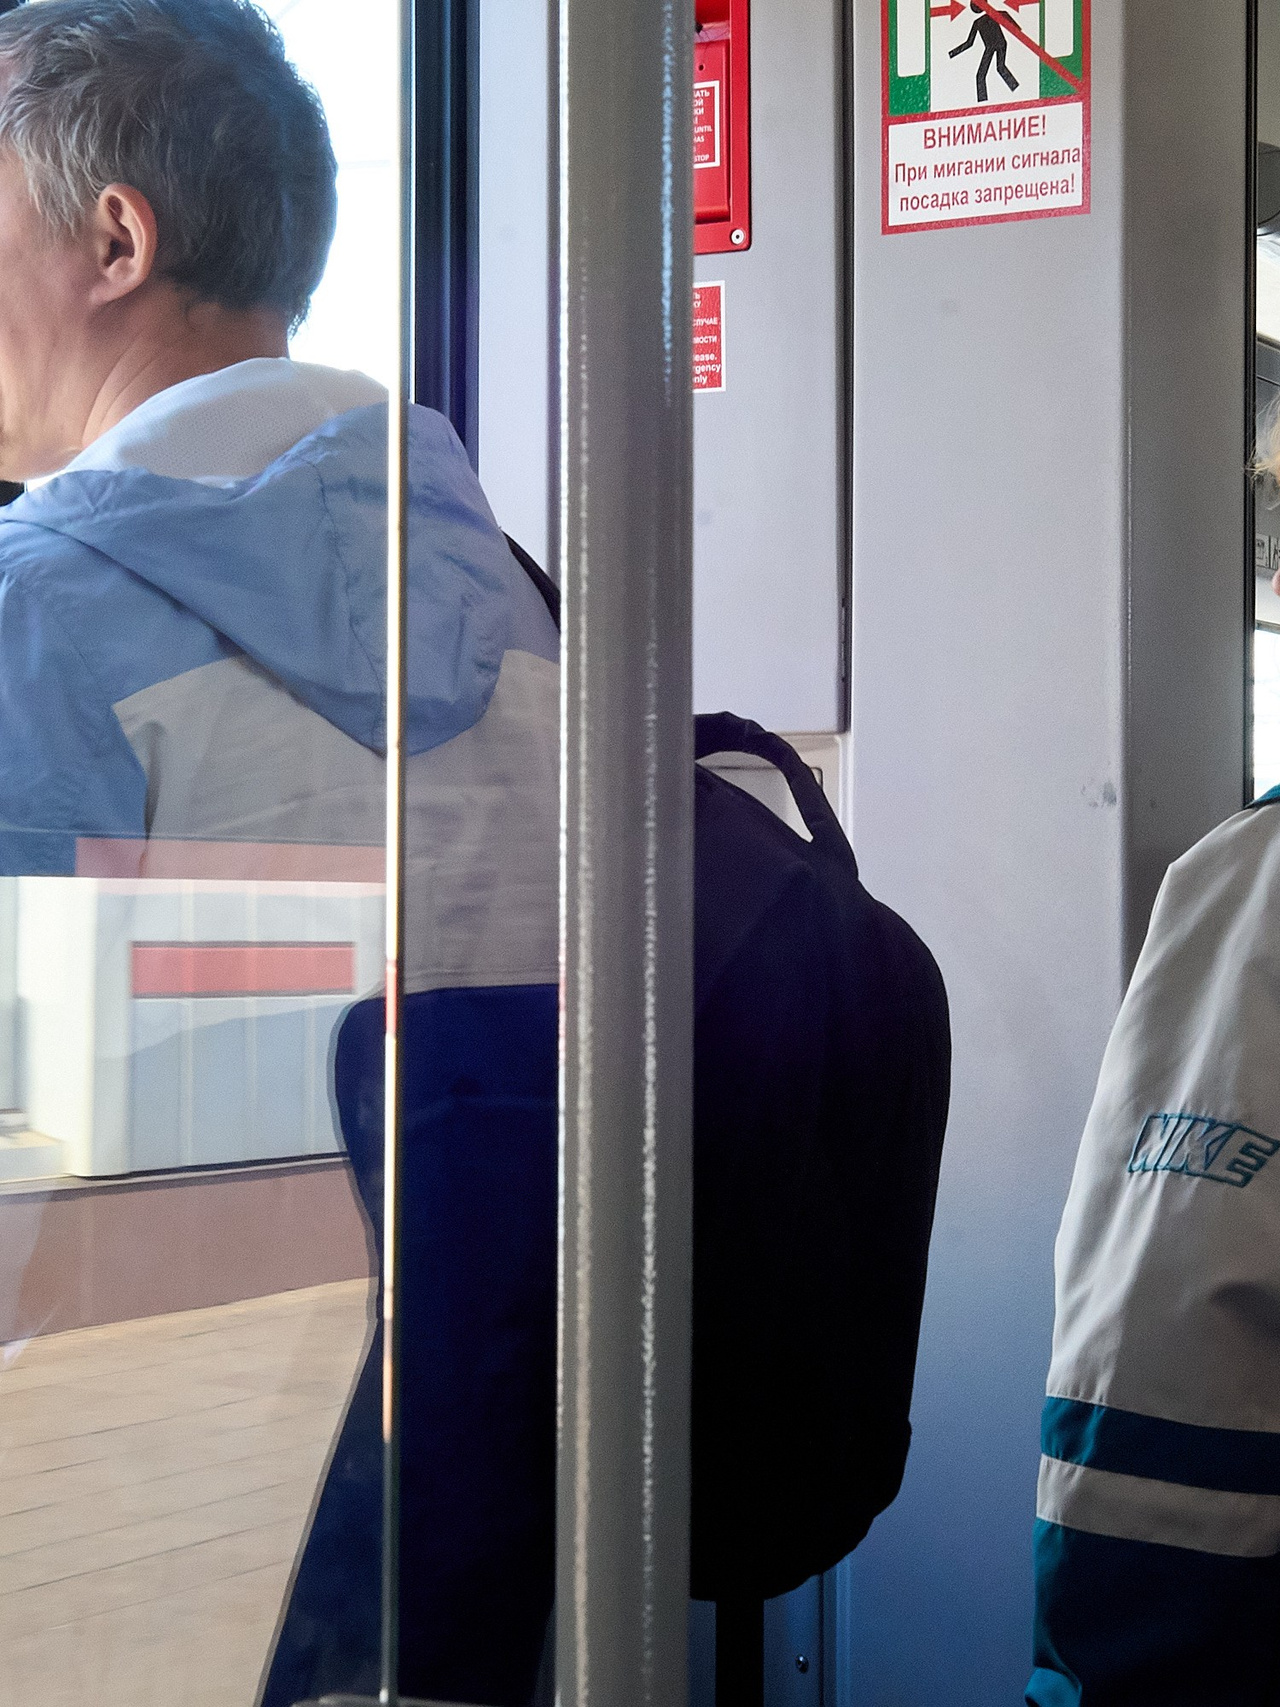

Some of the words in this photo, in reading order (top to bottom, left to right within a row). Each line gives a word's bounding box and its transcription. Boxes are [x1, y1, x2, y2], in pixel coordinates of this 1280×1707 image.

[923, 114, 1047, 150] ВНИМАНИЕ!
[895, 162, 928, 186] При
[933, 157, 1006, 179] мигании
[1011, 147, 1081, 170] сигнала
[899, 190, 969, 212] посадка
[974, 173, 1076, 206] запрещена!
